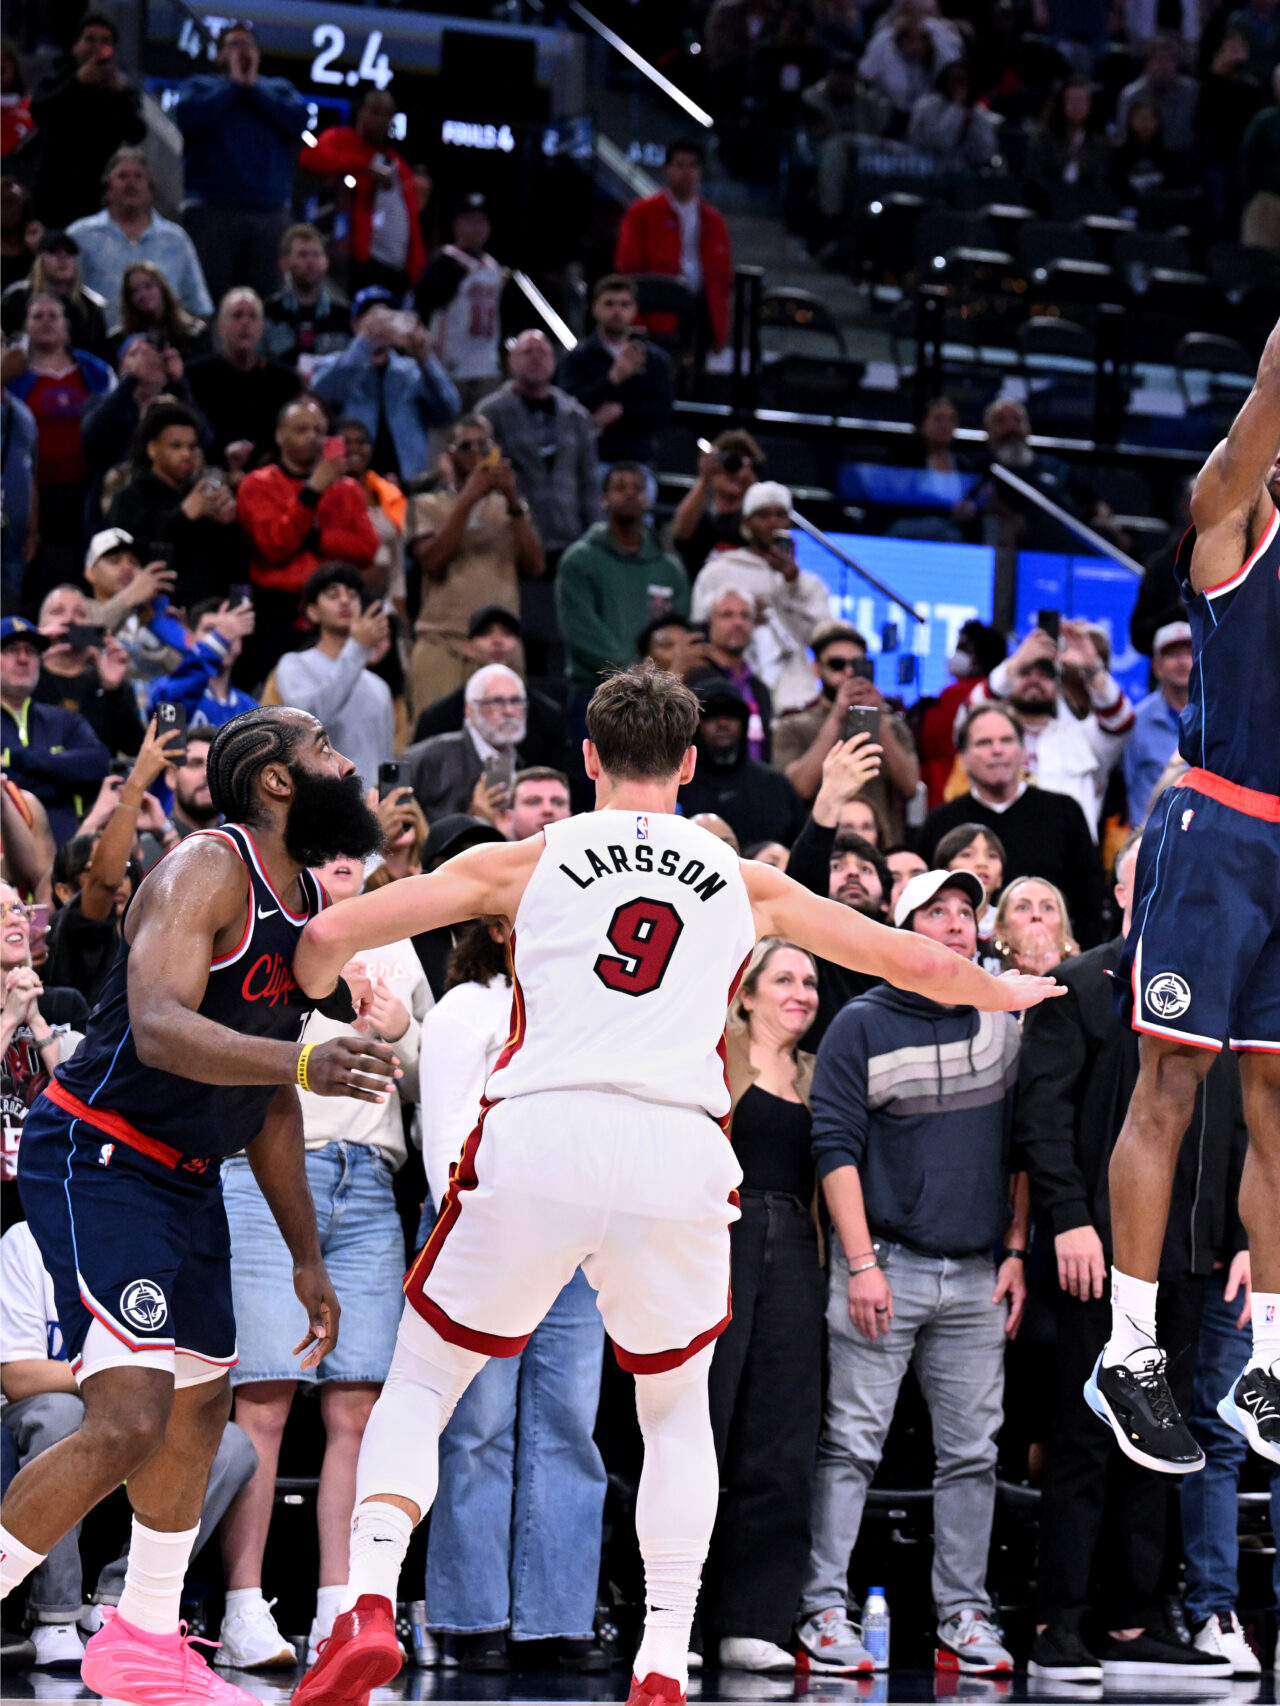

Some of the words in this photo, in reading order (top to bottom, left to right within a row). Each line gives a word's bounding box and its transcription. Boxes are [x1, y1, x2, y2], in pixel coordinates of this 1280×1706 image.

[310, 23, 394, 90] 2.4
[558, 844, 728, 902] LARSSON
[593, 896, 685, 997] 9
